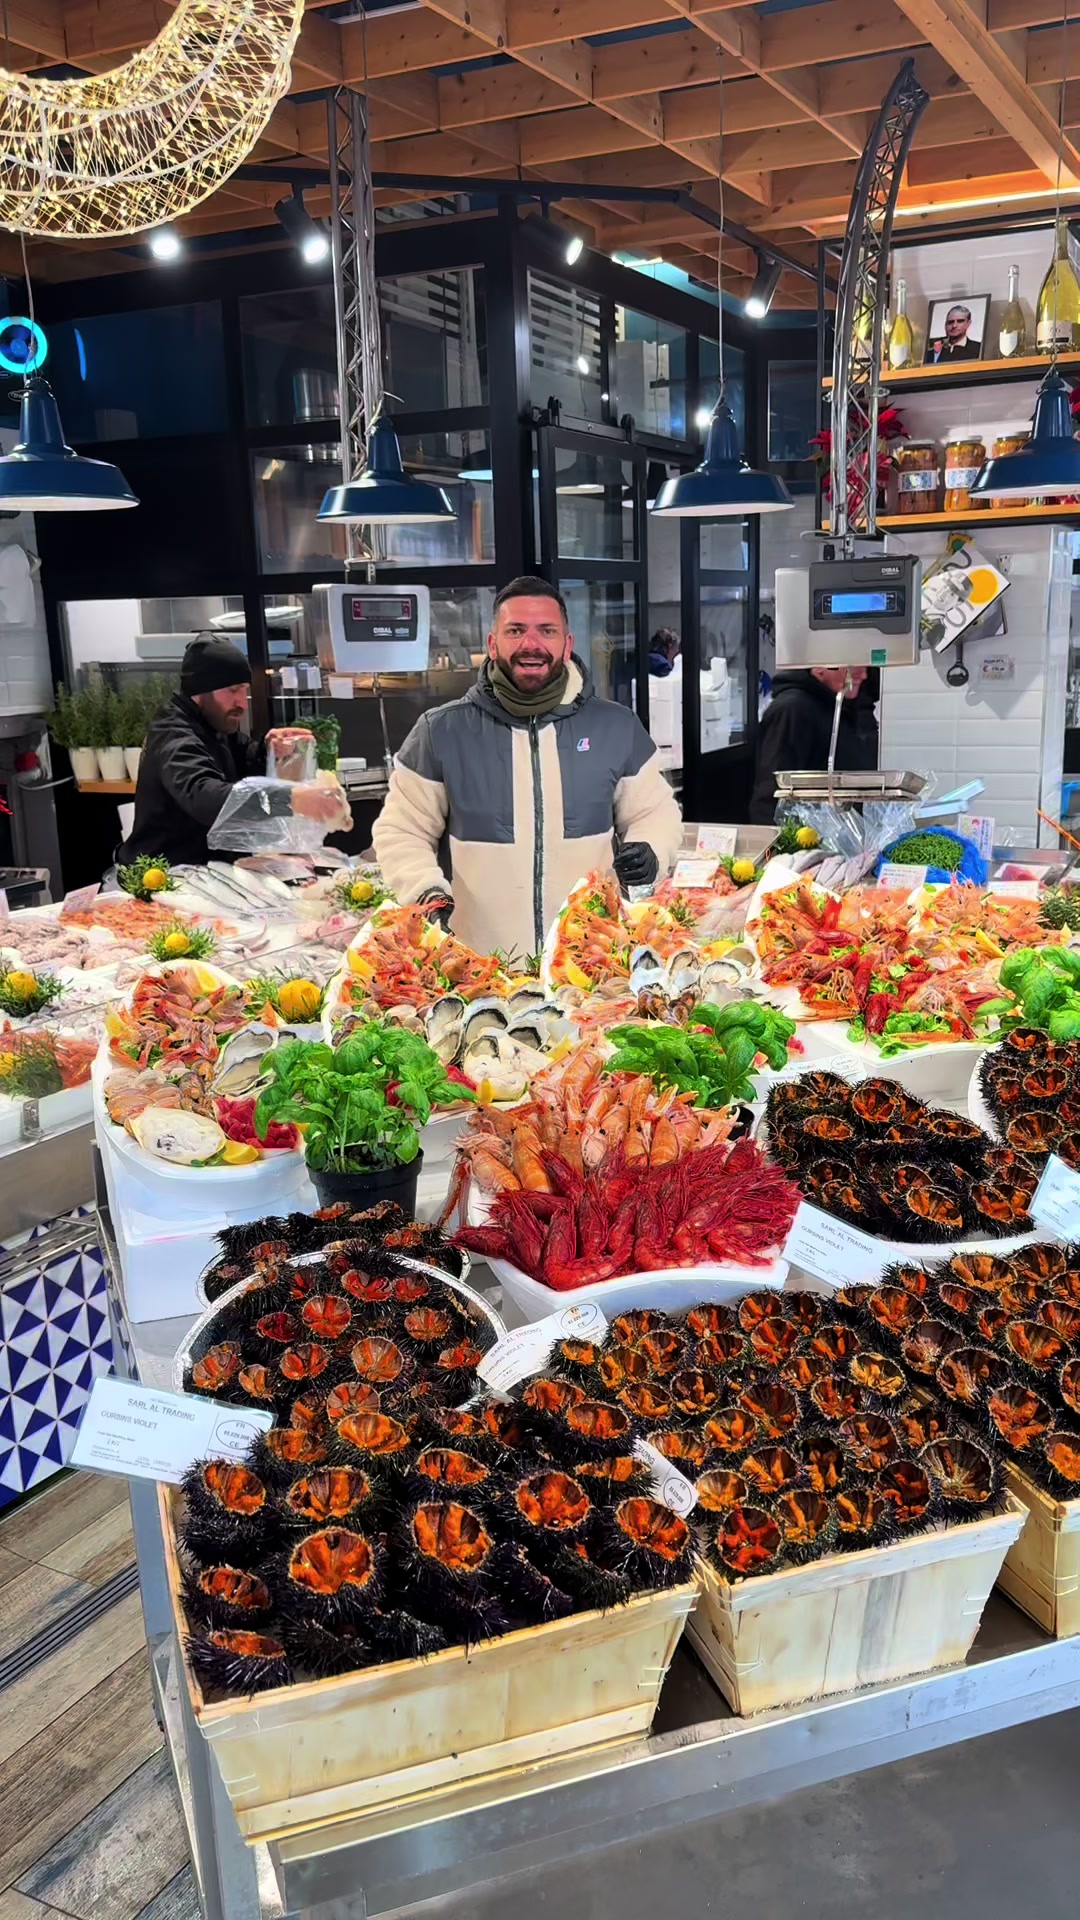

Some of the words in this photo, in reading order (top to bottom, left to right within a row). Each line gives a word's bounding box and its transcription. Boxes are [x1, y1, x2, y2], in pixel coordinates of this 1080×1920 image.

[820, 1222, 836, 1235] SARL
[837, 1232, 845, 1240] AL
[847, 1236, 873, 1254] TRADING
[825, 1238, 845, 1252] VIOLET
[505, 1343, 525, 1357] VIOLET
[127, 1398, 148, 1411] SARL
[149, 1404, 159, 1413] AL
[162, 1406, 196, 1421] TRADING
[133, 1417, 158, 1430] VIOLET
